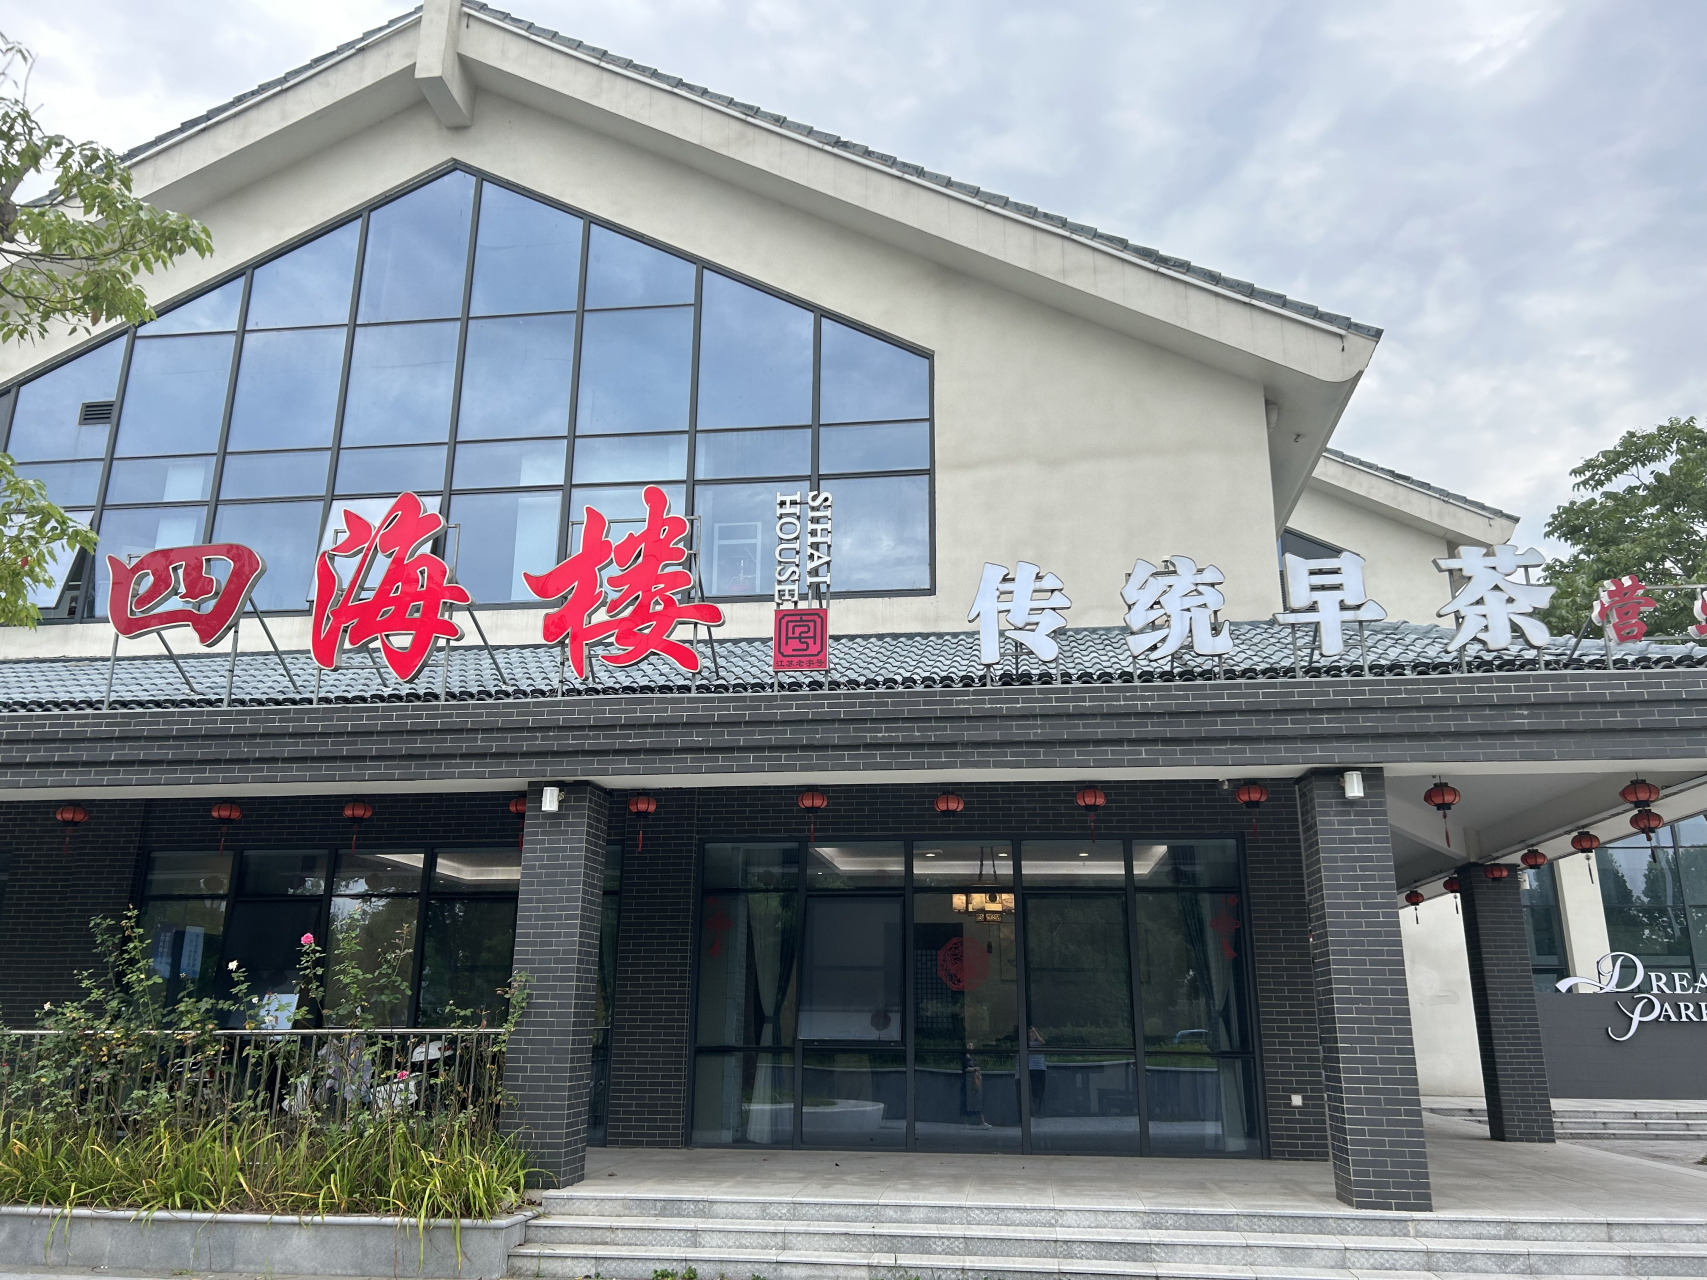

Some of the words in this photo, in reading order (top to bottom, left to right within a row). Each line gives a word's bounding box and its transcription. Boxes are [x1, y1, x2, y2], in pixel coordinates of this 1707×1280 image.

[107, 484, 725, 682] 四海楼
[774, 491, 801, 604] HOUSE
[806, 490, 833, 586] SIHAI
[967, 544, 1556, 665] 传统早茶
[1591, 574, 1707, 646] 营
[775, 658, 825, 668] 江苏老字号
